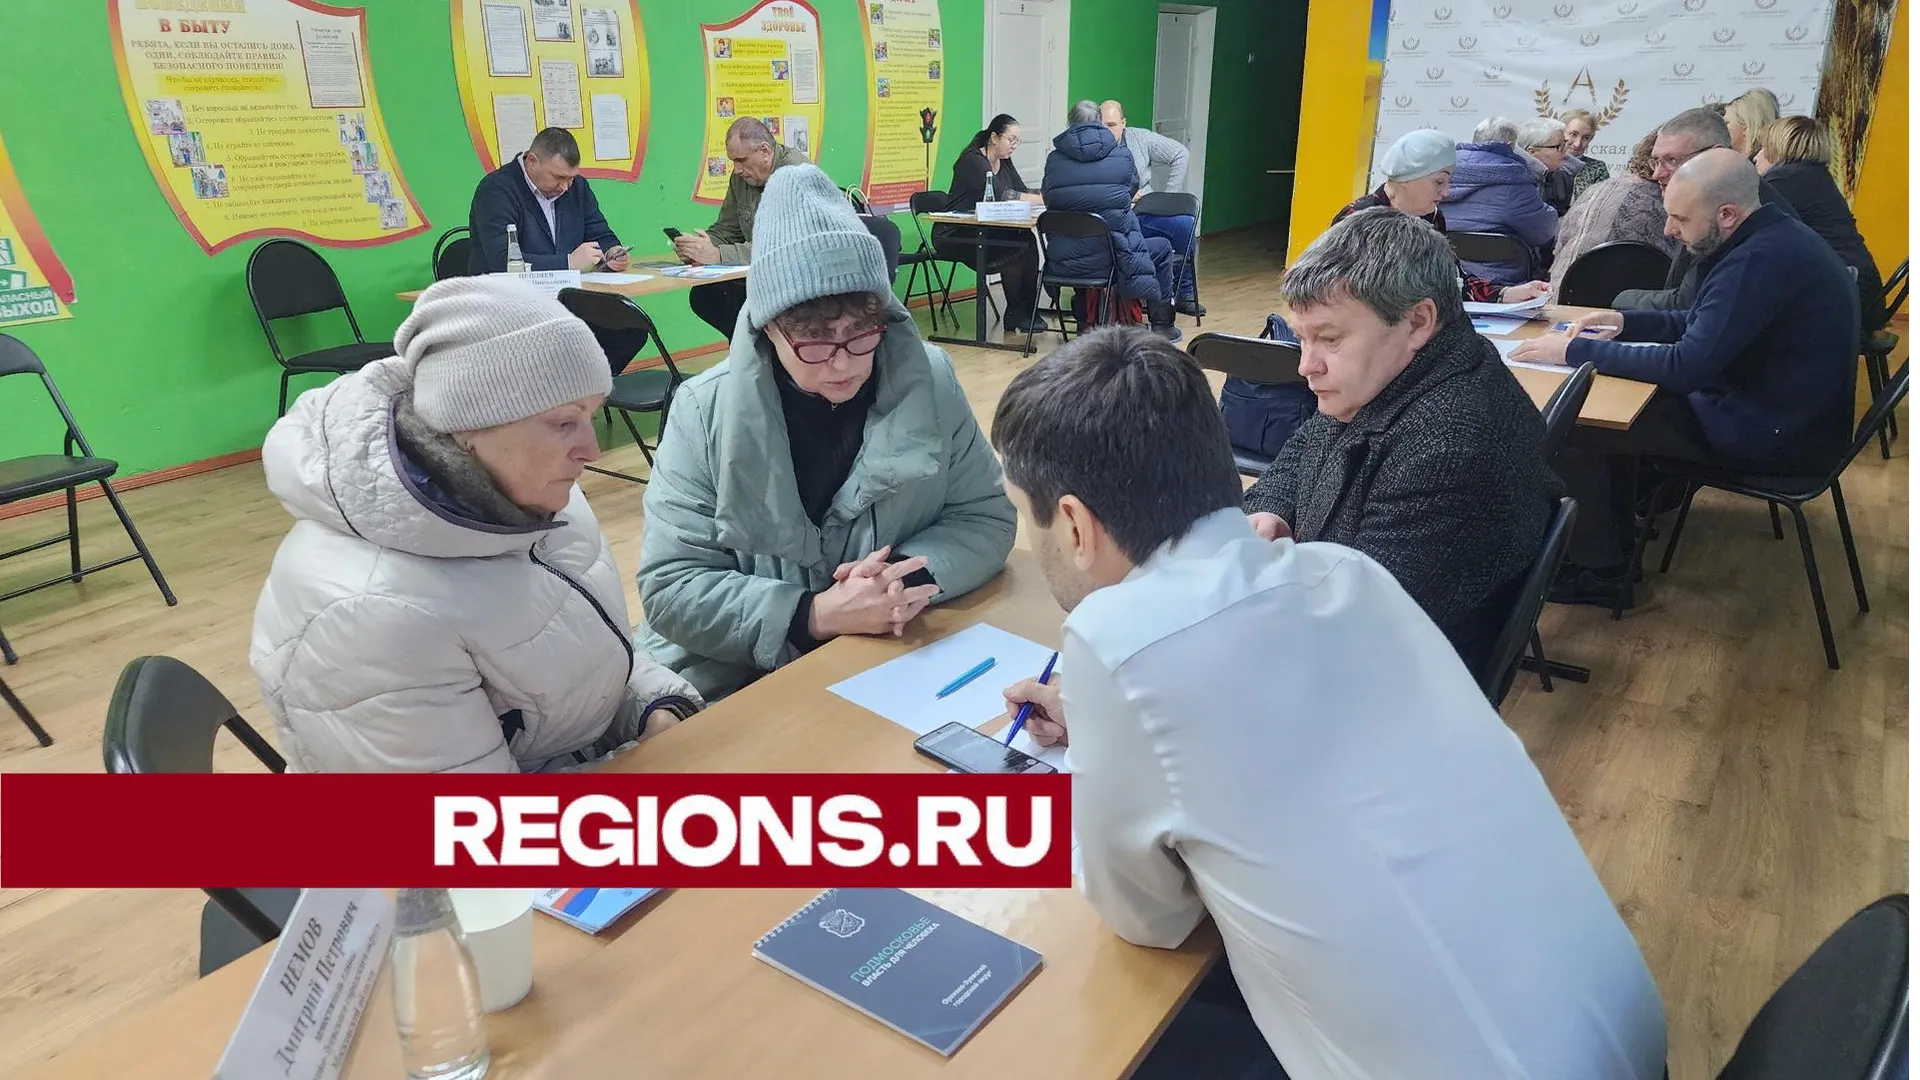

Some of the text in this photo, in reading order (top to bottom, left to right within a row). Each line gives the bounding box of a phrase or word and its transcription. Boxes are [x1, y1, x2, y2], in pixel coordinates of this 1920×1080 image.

[159, 19, 231, 34] В БЫТУ
[760, 20, 807, 33] ЗДОРОВЬЕ
[131, 40, 296, 51] РЕБЯТА, ЕСЛИ ВЫ ОСТАЛИСЬ ДОМА
[145, 51, 288, 60] ОДНИ, СОБЛЮДАЙТЕ ПРАВИЛА
[153, 61, 284, 71] БЕЗОПАСНОГО ПОВЕДЕНИЯ!
[0, 299, 58, 318] ЫХОД
[279, 916, 323, 998] НЕМОВ
[850, 916, 932, 982] ПОДМОСКОВЬЕ
[862, 922, 940, 987] ВЛАСТЬ ДЛЯ ЧЕЛОВЕКА
[274, 900, 359, 1078] Дмитрий Петрович
